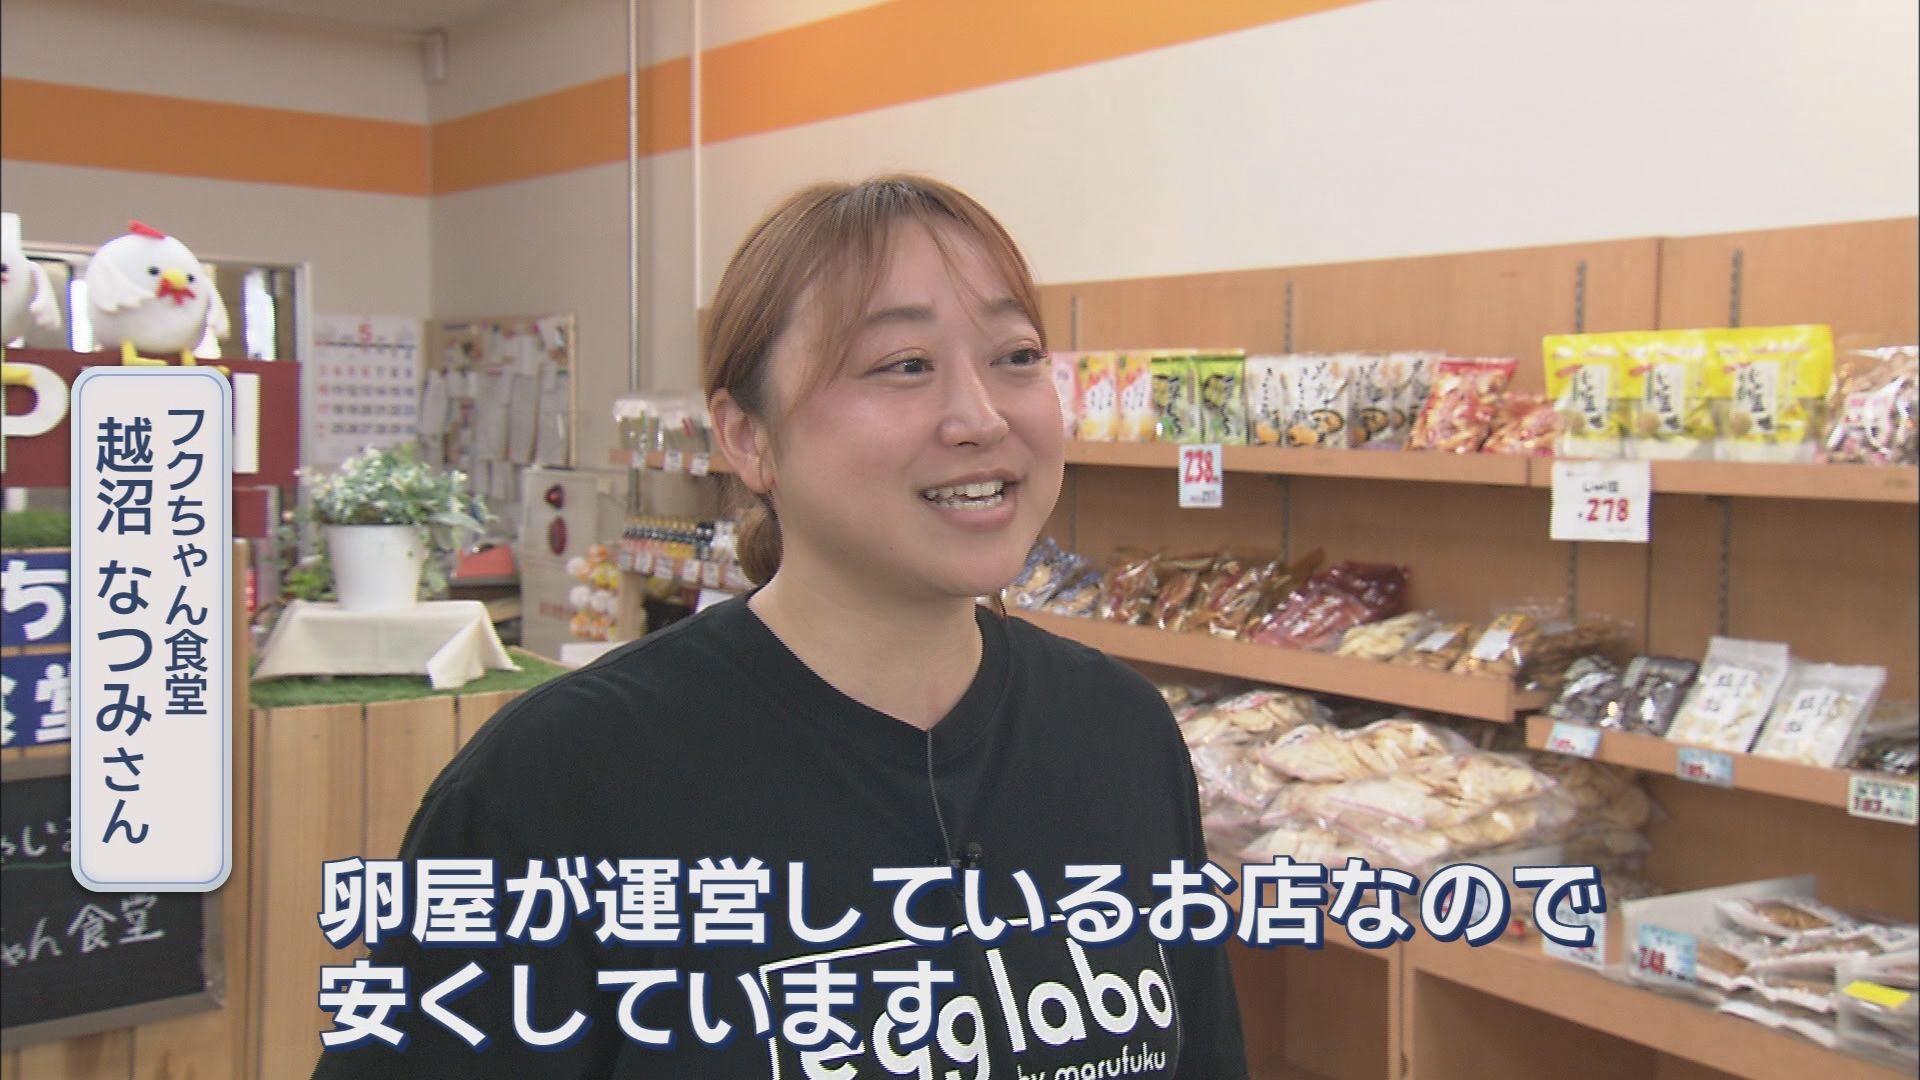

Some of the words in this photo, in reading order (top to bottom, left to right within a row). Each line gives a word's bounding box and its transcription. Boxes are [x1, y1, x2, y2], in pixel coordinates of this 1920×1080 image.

[1183, 449, 1214, 484] 238
[986, 937, 1173, 1053] labo
[1054, 1041, 1166, 1080] marufuku
